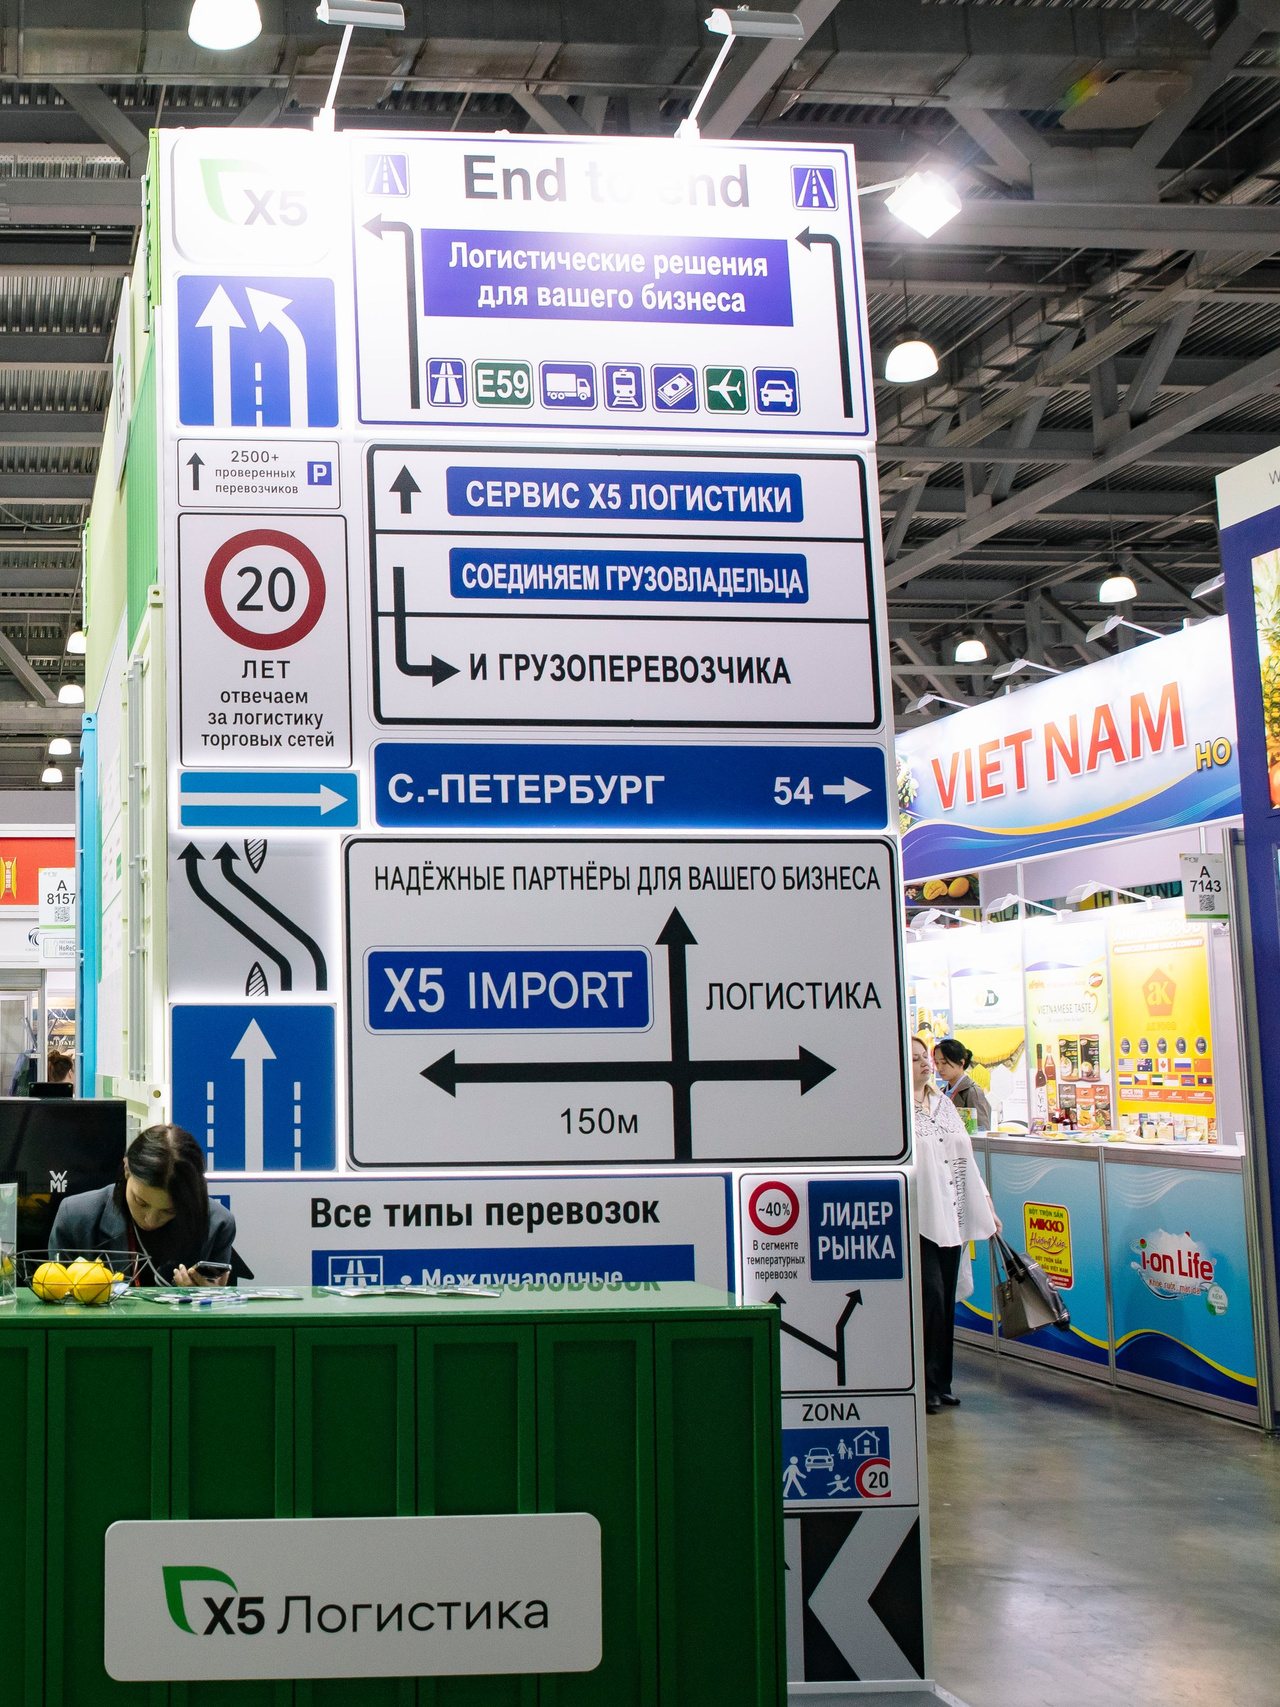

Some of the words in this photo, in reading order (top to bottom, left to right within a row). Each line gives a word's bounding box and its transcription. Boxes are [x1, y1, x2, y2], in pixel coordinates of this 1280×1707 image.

[463, 154, 567, 202] End
[656, 163, 751, 208] end
[243, 189, 308, 226] X5
[449, 241, 646, 274] Логистические
[654, 253, 769, 279] решения
[477, 284, 529, 309] для
[537, 287, 634, 310] вашего
[641, 283, 747, 313] бизнеса
[476, 369, 530, 399] E59
[230, 450, 280, 463] 2500+
[215, 467, 297, 482] проверенных
[312, 464, 327, 484] P
[215, 483, 299, 496] перевозчиков
[465, 480, 581, 509] СЕРВИС
[588, 483, 622, 511] X5
[629, 484, 793, 514] ЛОГИСТИКИ
[236, 566, 296, 612] 20
[461, 562, 600, 594] СОЕДИНЯЕМ
[605, 565, 804, 598] ГРУЗОВЛАДЕЛЬЦА
[241, 660, 291, 679] ЛЕТ
[469, 653, 487, 681] И
[498, 653, 792, 685] ГРУЗОПЕРЕВОЗЧИКА
[220, 690, 309, 704] отвечаем
[207, 712, 227, 725] за
[232, 712, 324, 730] логистику
[201, 732, 282, 750] торговых
[287, 731, 335, 747] сетей
[930, 728, 1034, 811] VIET
[1043, 681, 1188, 784] NAM
[387, 773, 666, 805] С.-ПЕТЕРБУРГ
[773, 776, 814, 806] 54
[374, 862, 506, 895] НАДЁЖНЫЕ
[513, 861, 631, 891] ПАРТНЁРЫ
[637, 866, 682, 896] ДЛЯ
[688, 866, 777, 891] ВАШЕГО
[783, 865, 881, 891] БИЗНЕСА
[1199, 865, 1211, 878] A
[47, 892, 76, 905] 8157
[56, 879, 68, 892] A
[1190, 879, 1222, 893] 7143
[383, 967, 446, 1013] X5
[468, 970, 633, 1010] IMPORT
[705, 981, 883, 1011] ЛОГИСТИКА
[559, 1107, 640, 1135] 150м
[310, 1197, 373, 1228] Все
[383, 1202, 473, 1228] типы
[485, 1199, 661, 1234] перевозок
[820, 1201, 894, 1230] ЛИДЕР
[1029, 1217, 1065, 1233] MIKKO
[752, 1240, 758, 1250] В
[760, 1241, 799, 1251] сегменте
[818, 1235, 896, 1260] РЫНКА
[746, 1255, 806, 1267] температурных
[1177, 1249, 1214, 1281] Life
[754, 1270, 798, 1281] перевозок
[802, 1403, 861, 1422] ZONA
[868, 1471, 889, 1489] 20
[202, 1596, 266, 1636] X5
[276, 1595, 550, 1635] Логистика
